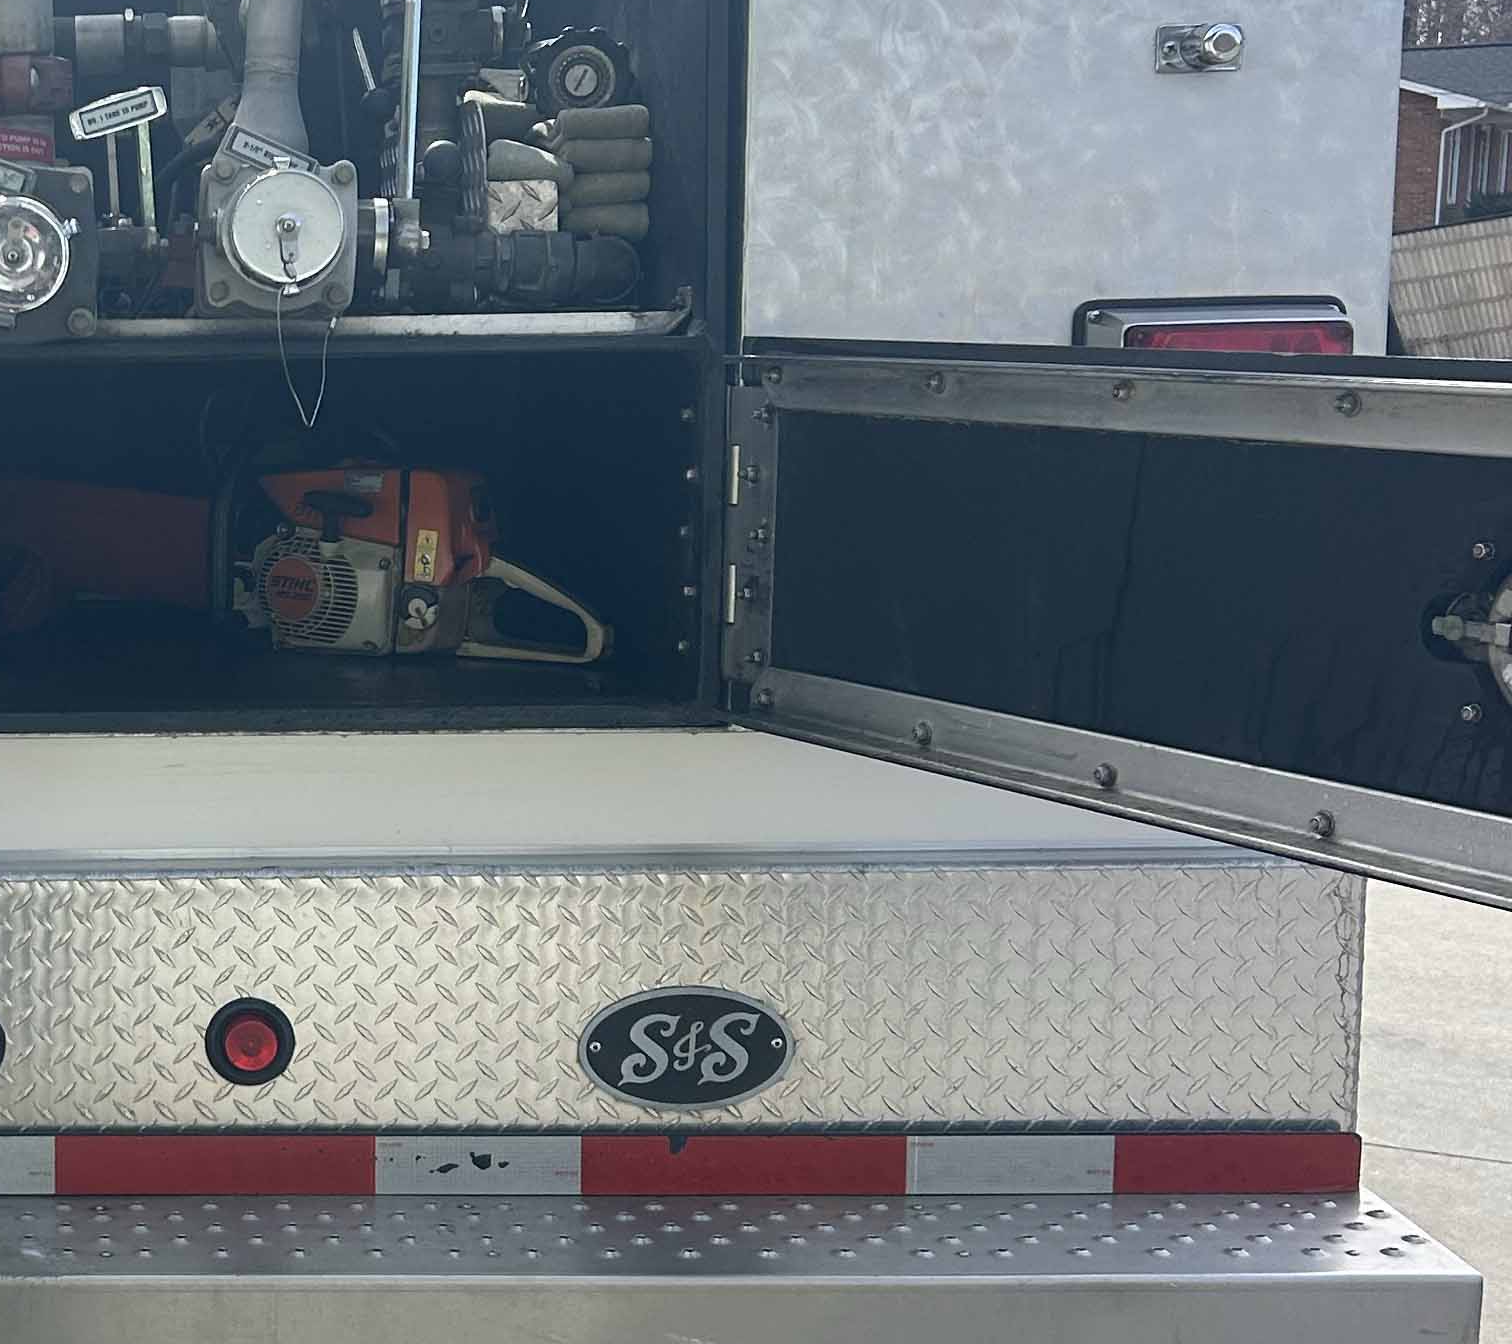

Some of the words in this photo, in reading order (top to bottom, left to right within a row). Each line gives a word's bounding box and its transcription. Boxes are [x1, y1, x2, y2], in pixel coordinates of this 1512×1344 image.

[9, 136, 31, 144] PUMP
[271, 576, 313, 589] STIHL
[617, 1012, 760, 1087] S&S
